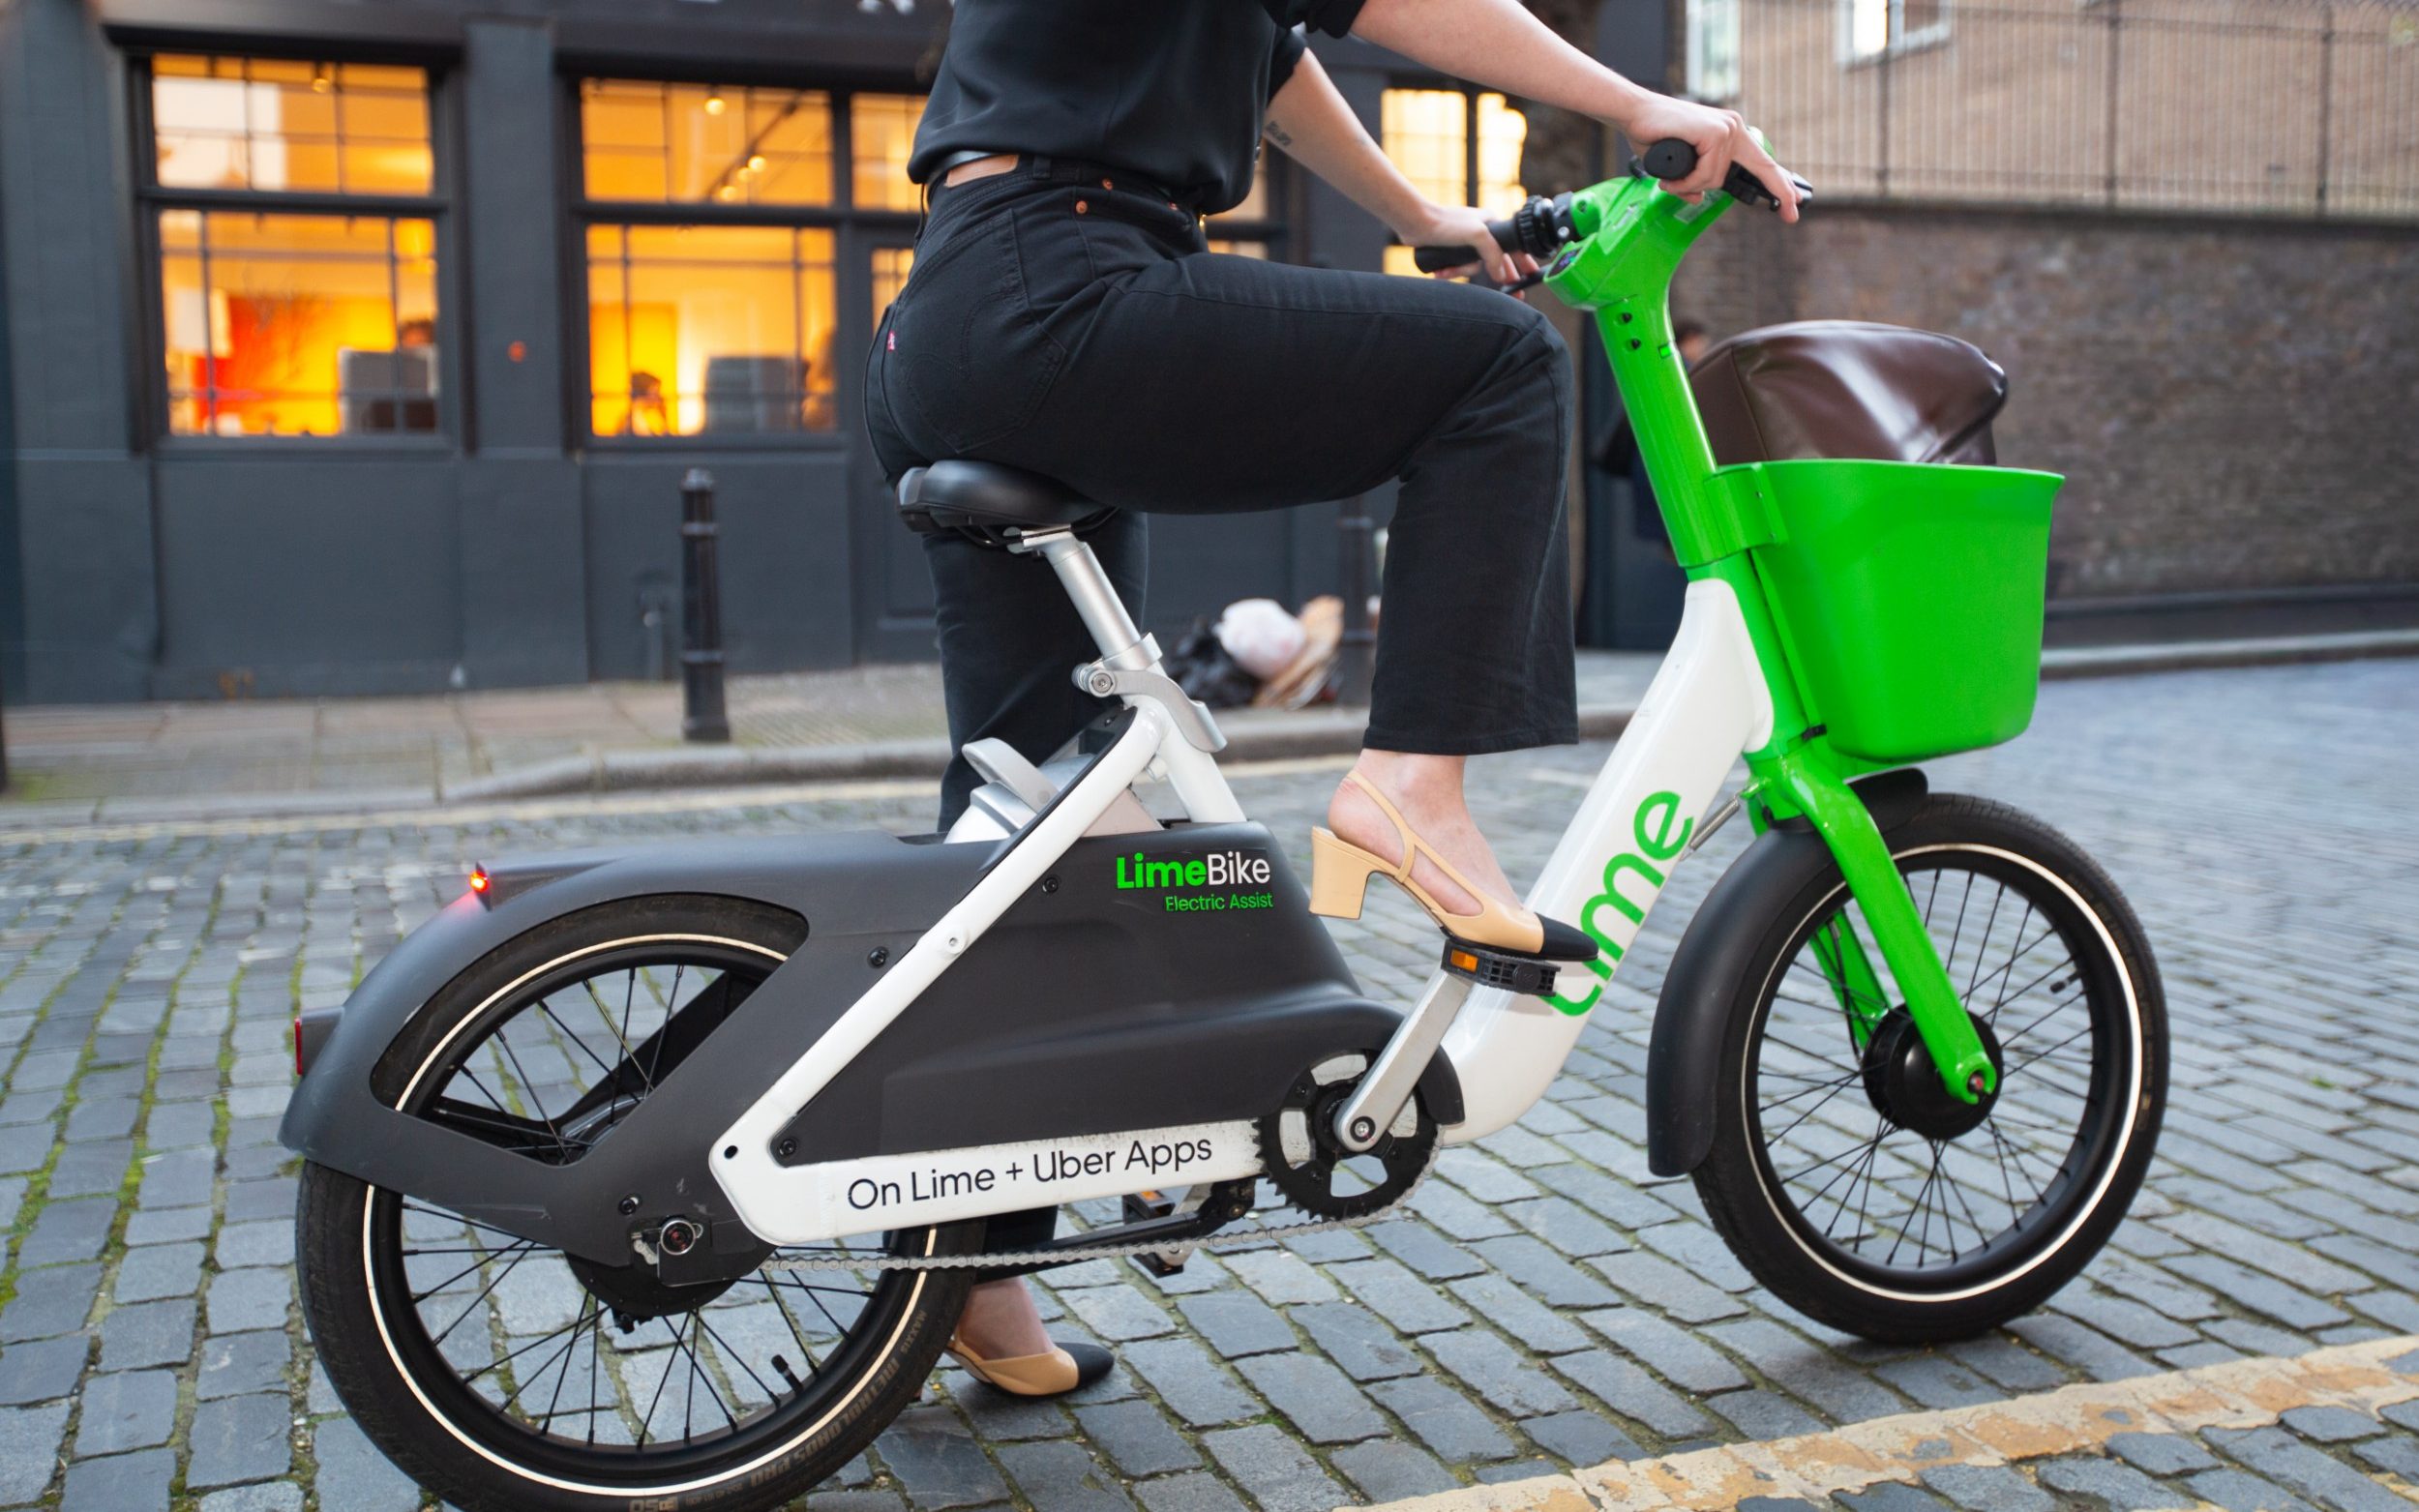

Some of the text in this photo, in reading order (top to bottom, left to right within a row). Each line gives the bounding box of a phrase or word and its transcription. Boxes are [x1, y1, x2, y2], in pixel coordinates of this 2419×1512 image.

[1116, 850, 1270, 889] LimeBike
[1164, 892, 1273, 912] Electric Assist
[848, 1139, 1212, 1210] On Lime + Uber Apps
[900, 1310, 927, 1353] MAXXIS
[750, 1457, 791, 1487] PRO
